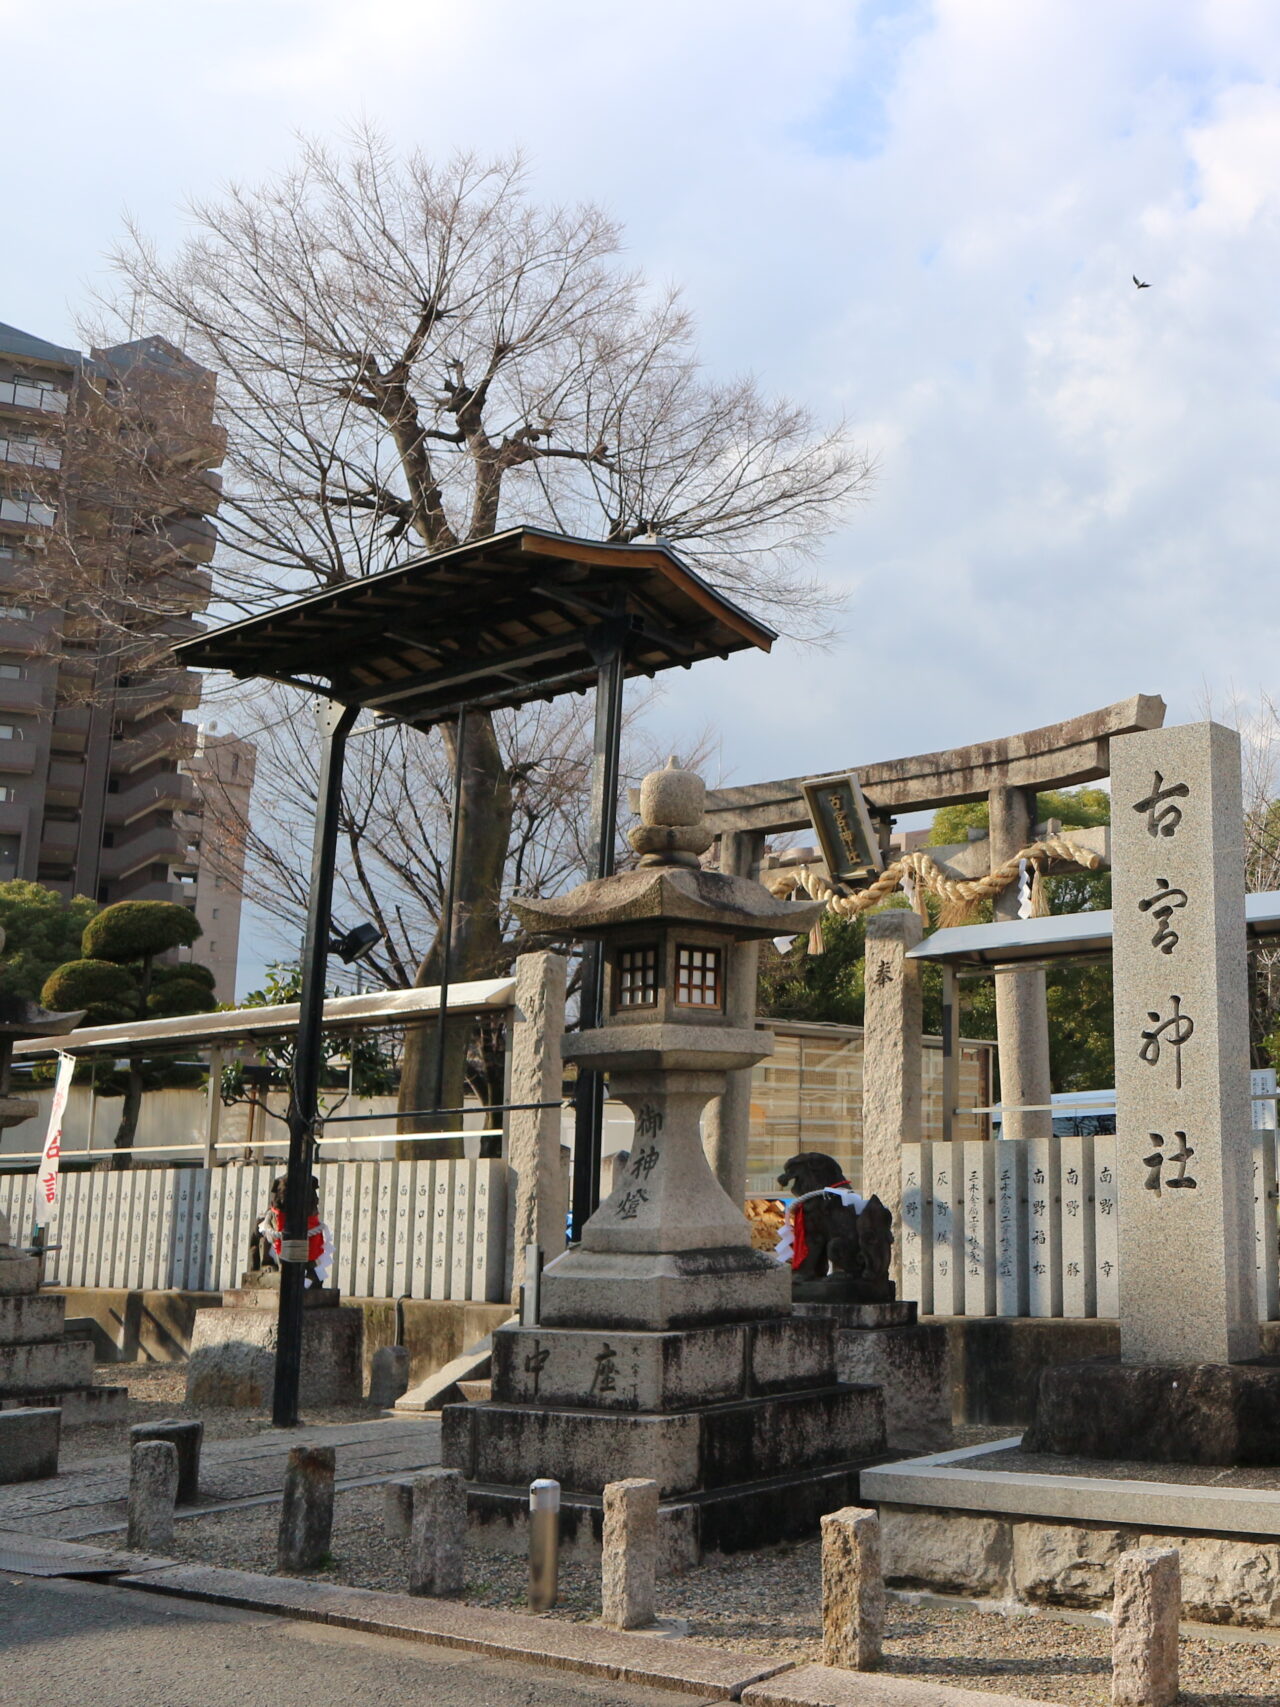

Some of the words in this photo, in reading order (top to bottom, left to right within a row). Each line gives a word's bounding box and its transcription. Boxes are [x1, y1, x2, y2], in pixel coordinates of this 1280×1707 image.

[875, 961, 894, 988] 奉
[1132, 770, 1198, 1198] 古宮神社
